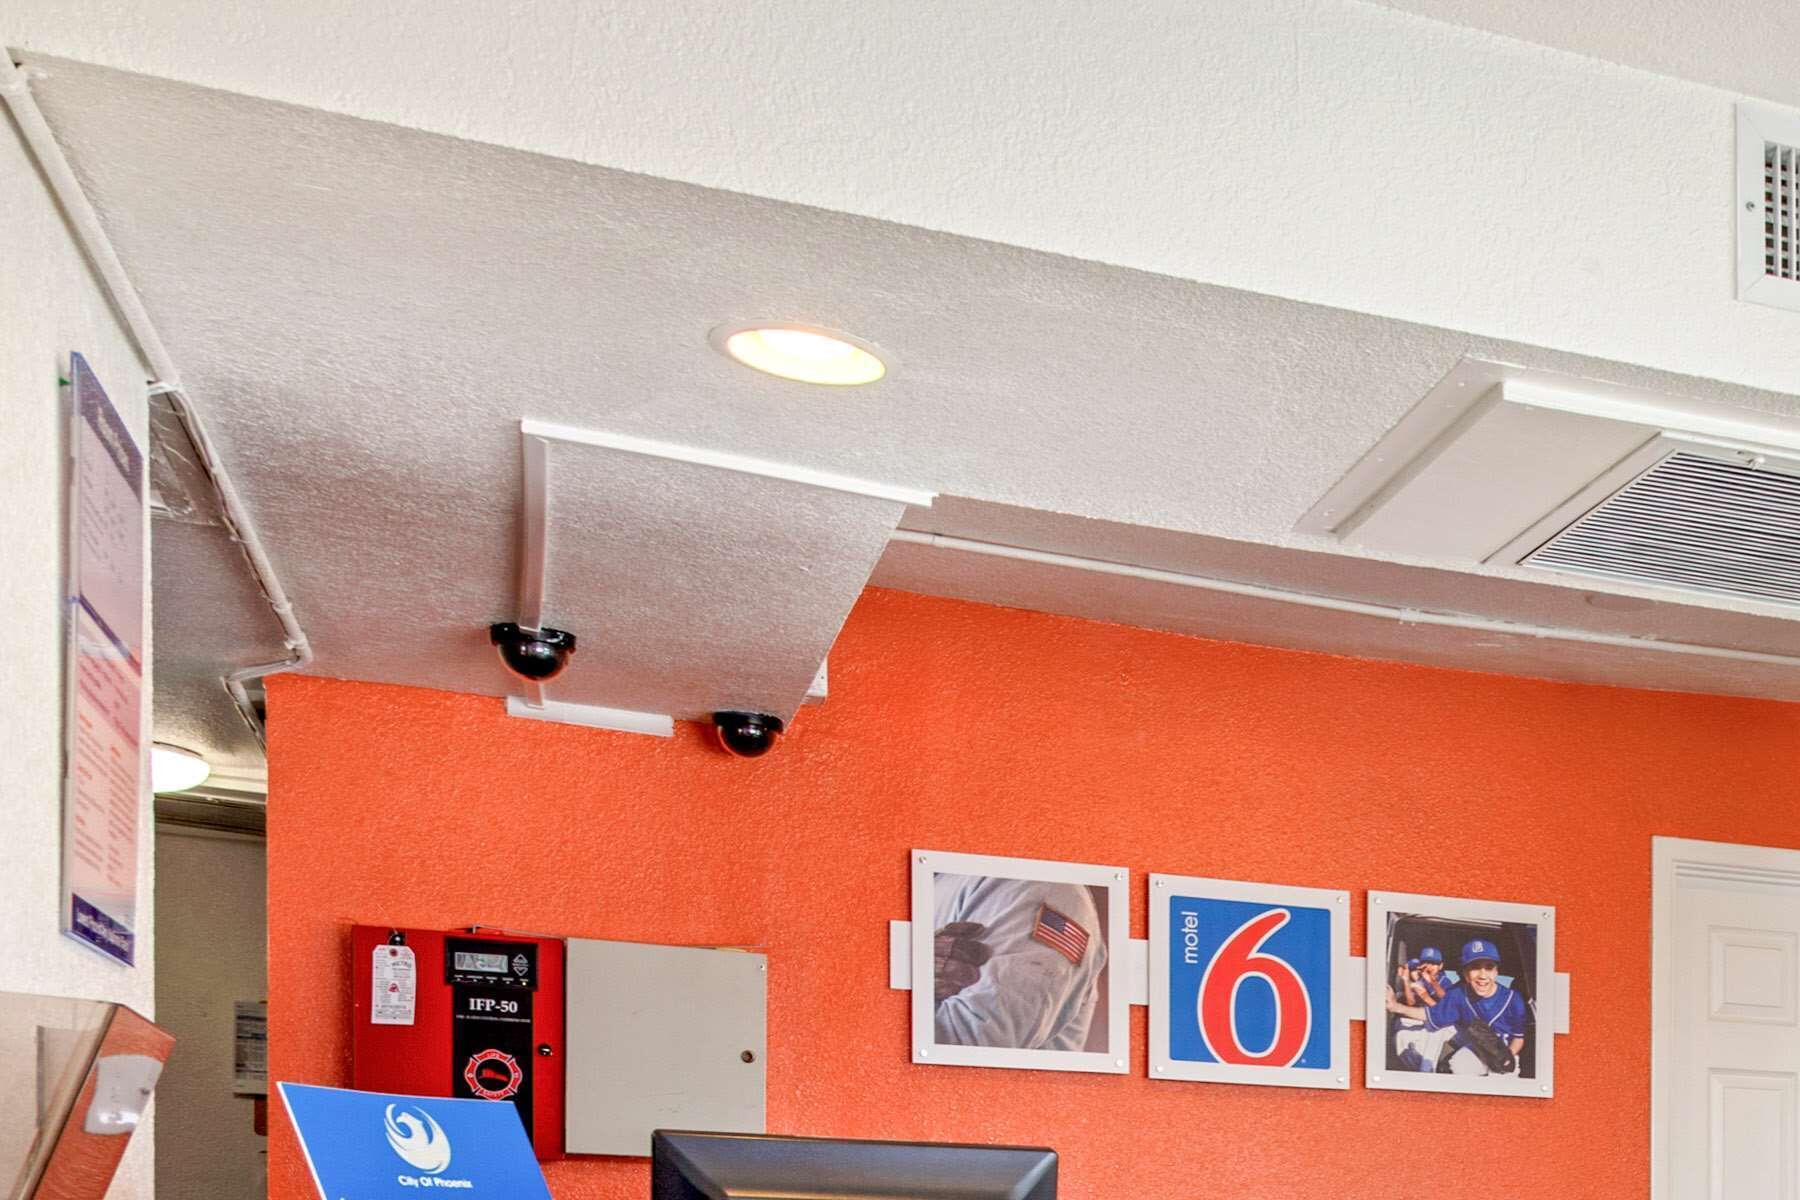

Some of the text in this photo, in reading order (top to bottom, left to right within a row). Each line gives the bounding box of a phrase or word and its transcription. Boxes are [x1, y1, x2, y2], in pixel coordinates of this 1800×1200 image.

[1181, 908, 1312, 1068] motel 6
[469, 998, 518, 1013] IFP-50
[398, 1175, 419, 1188] City
[433, 1177, 473, 1189] Phoenix
